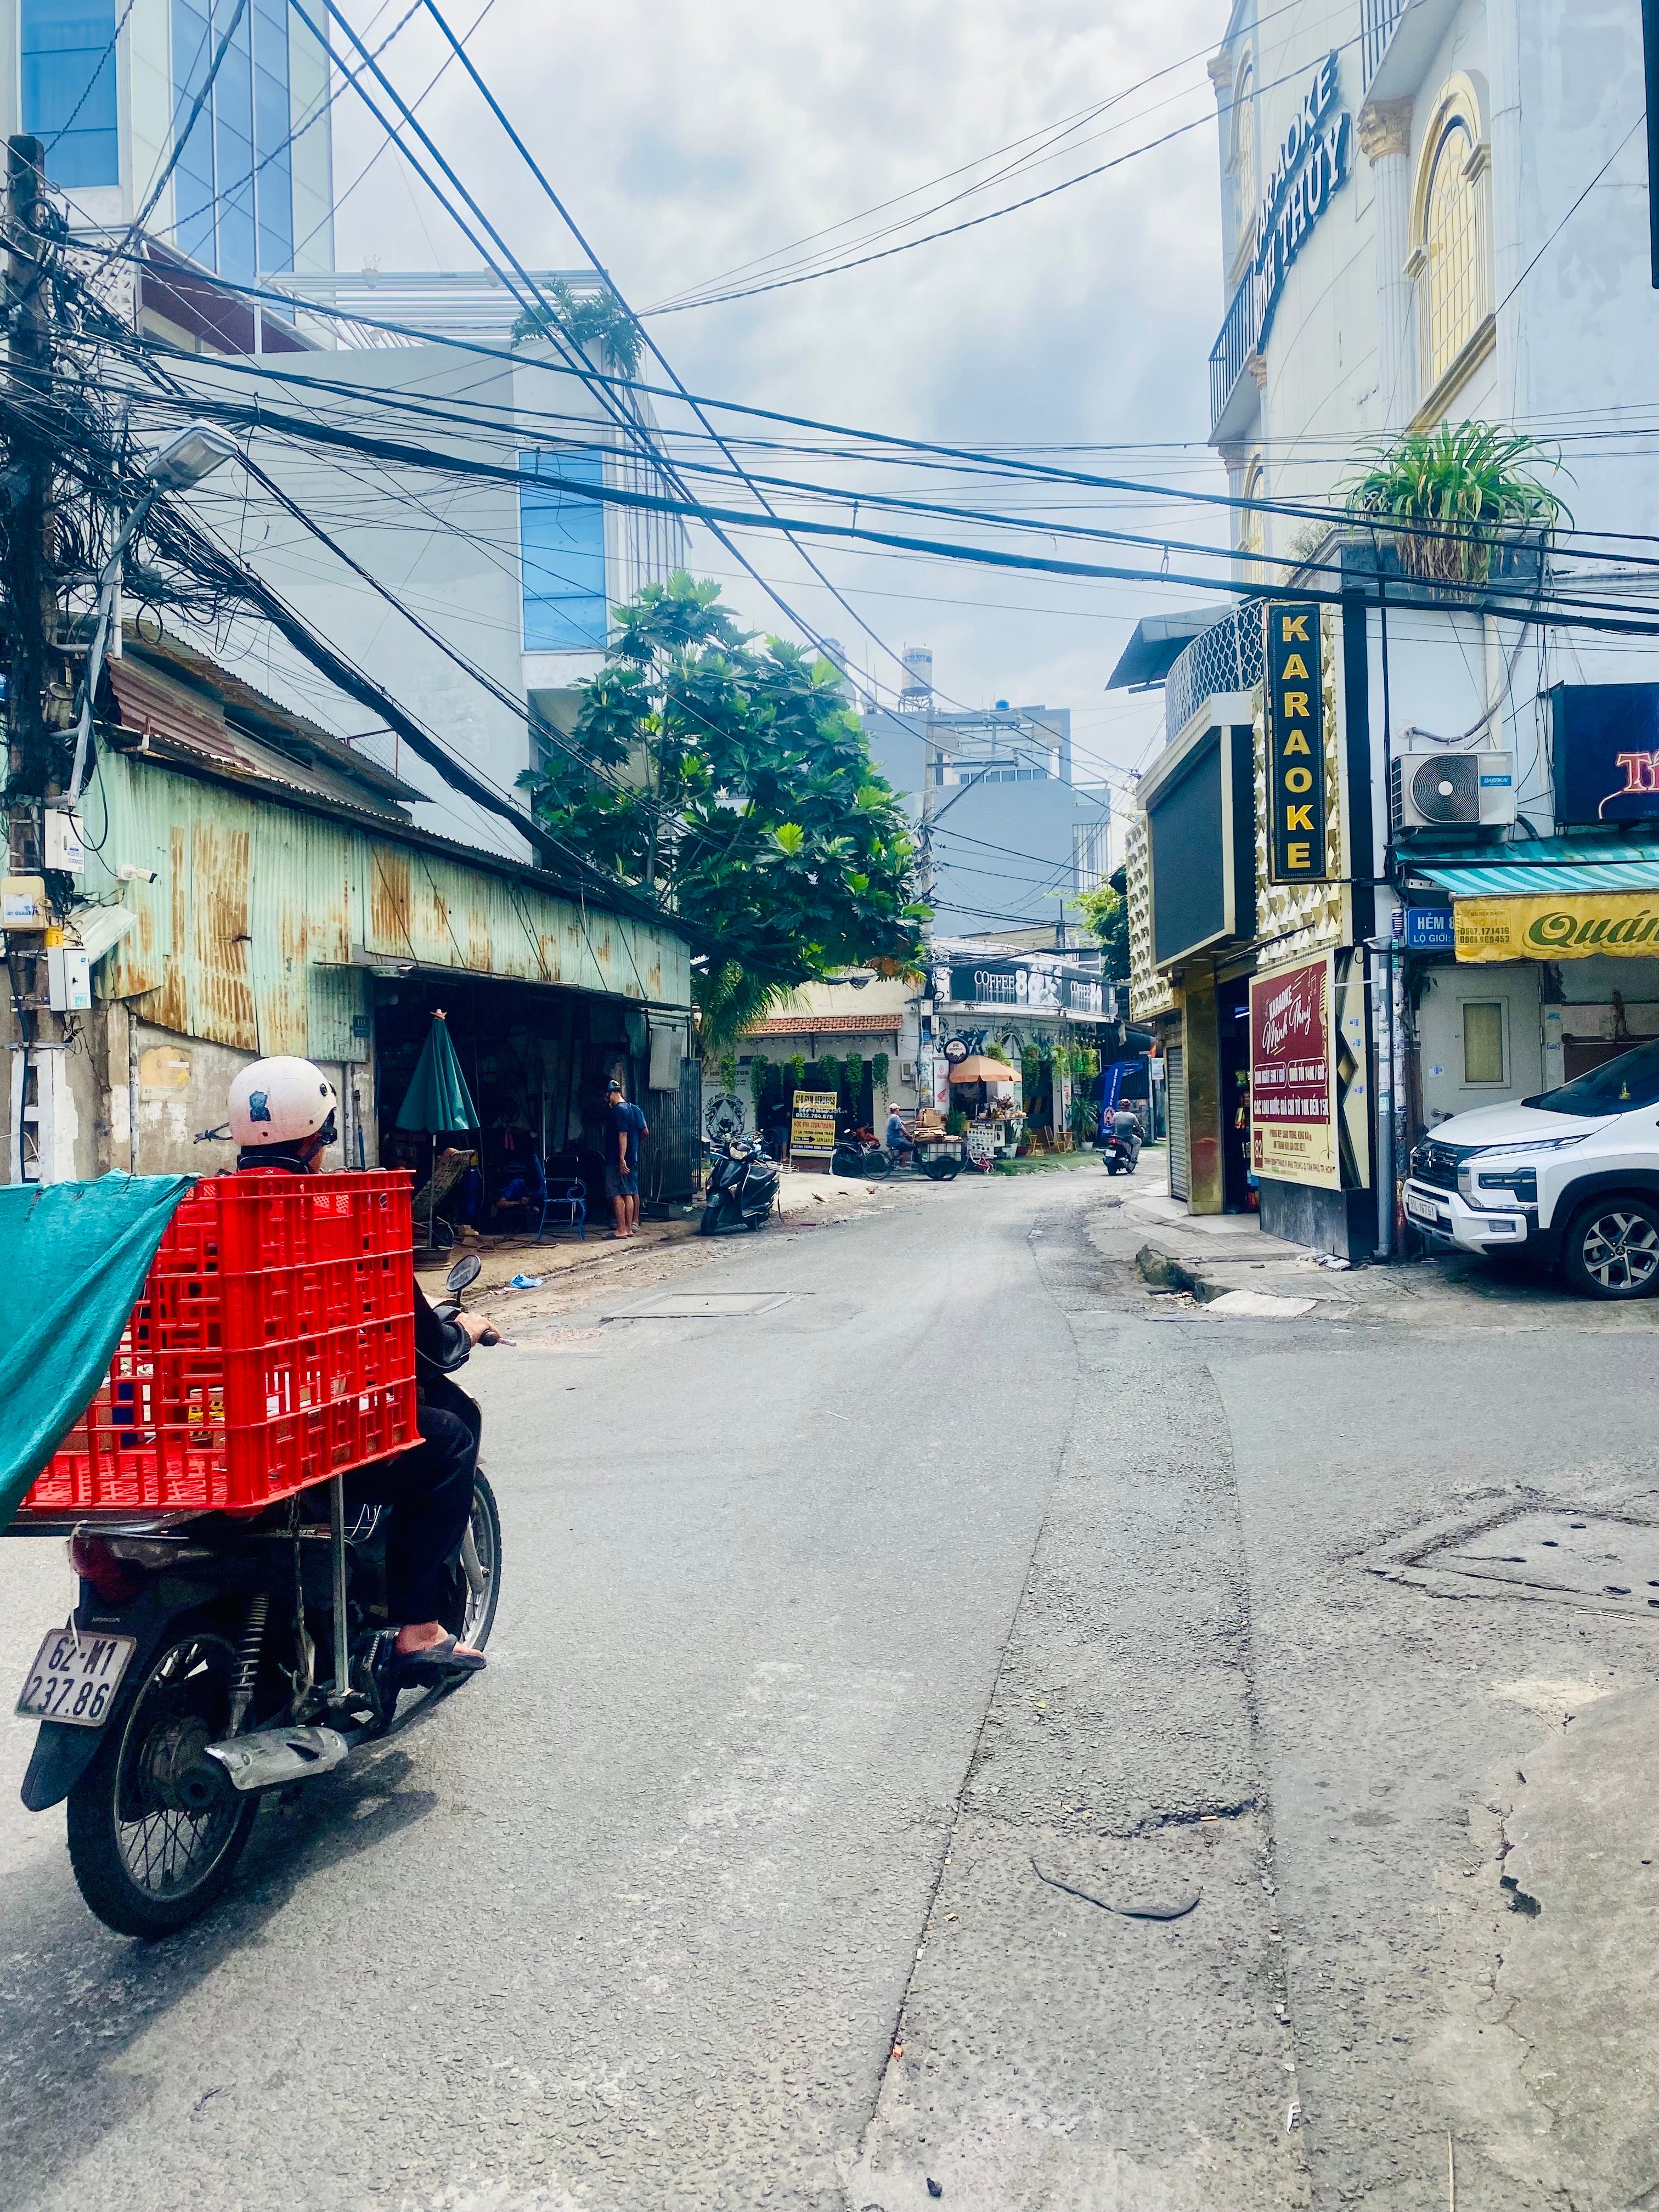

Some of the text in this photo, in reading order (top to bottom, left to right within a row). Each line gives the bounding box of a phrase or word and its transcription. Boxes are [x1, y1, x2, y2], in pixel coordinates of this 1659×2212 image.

[1253, 53, 1335, 274] KARAOKE
[1279, 112, 1347, 267] THỦY
[1282, 615, 1315, 869] KARAOKE
[1414, 933, 1426, 944] LỘ
[1417, 912, 1444, 930] HẺM
[974, 970, 1015, 990] COFFEE
[1070, 980, 1091, 998] COFFEE
[1269, 984, 1293, 1022] KARAOKE
[1262, 1011, 1288, 1055] Minh
[1255, 1139, 1262, 1159] 82
[25, 1675, 110, 1719] 237.86
